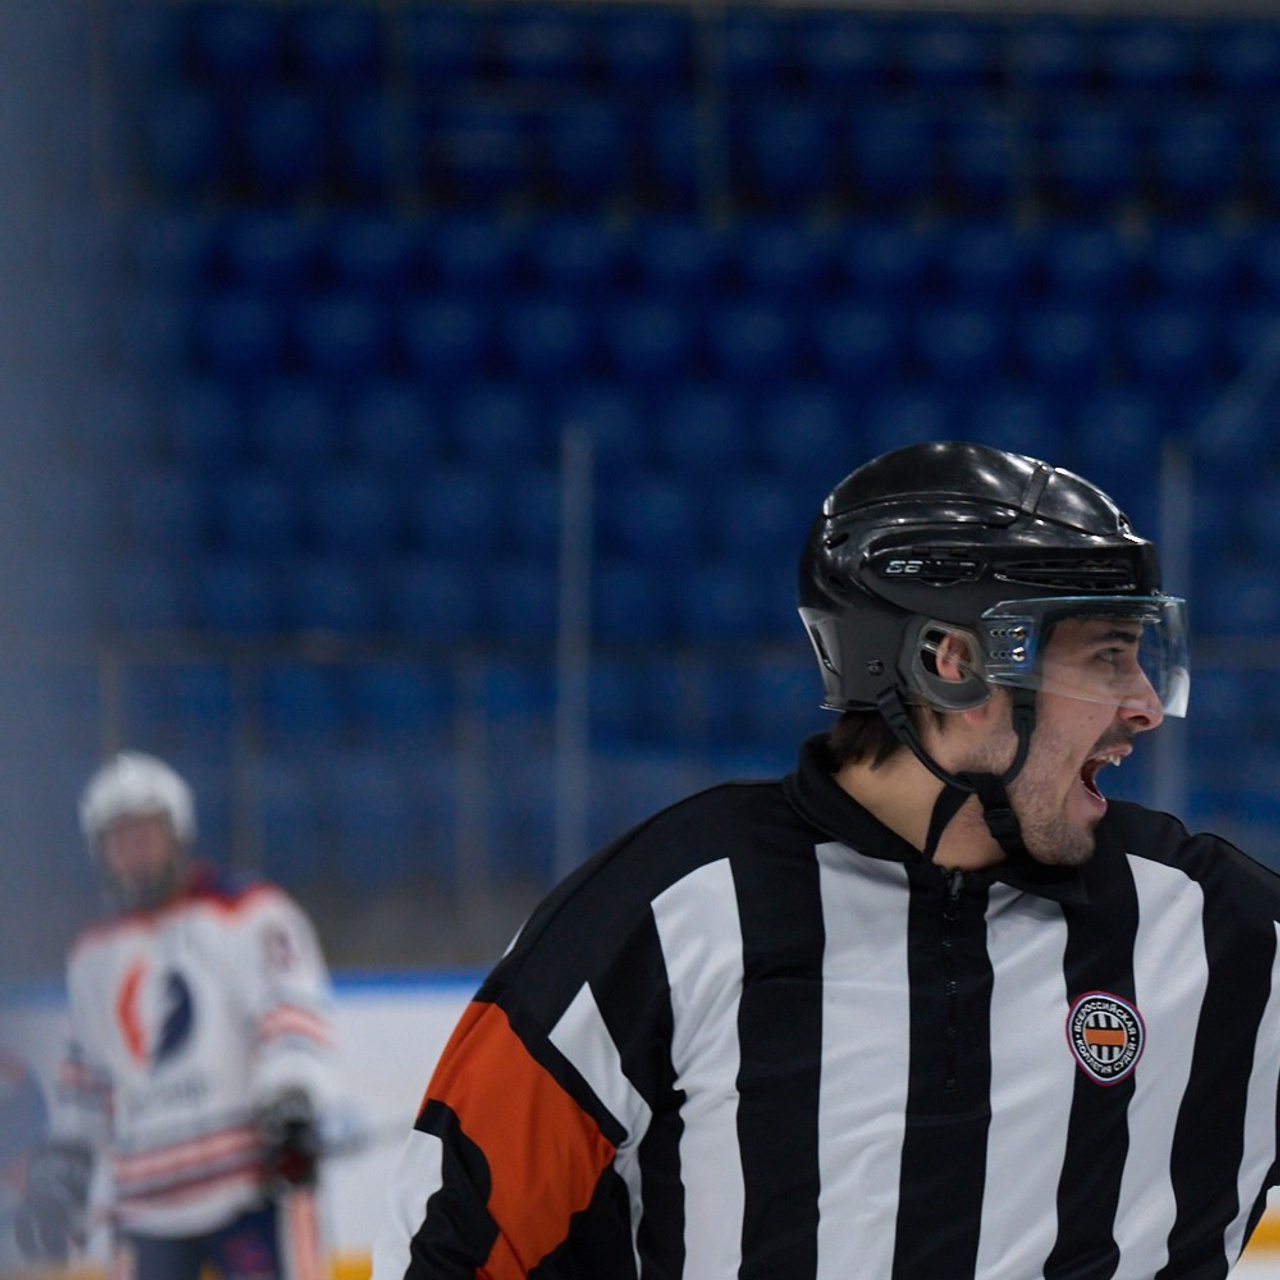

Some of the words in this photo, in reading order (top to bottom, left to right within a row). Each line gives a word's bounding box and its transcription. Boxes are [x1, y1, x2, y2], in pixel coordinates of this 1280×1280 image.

[1074, 1002, 1136, 1035] ВСЕРОССИЙСКАЯ
[1076, 1039, 1112, 1073] КОЛЛЕГИЯ
[1113, 1042, 1137, 1071] СУДЕЙ
